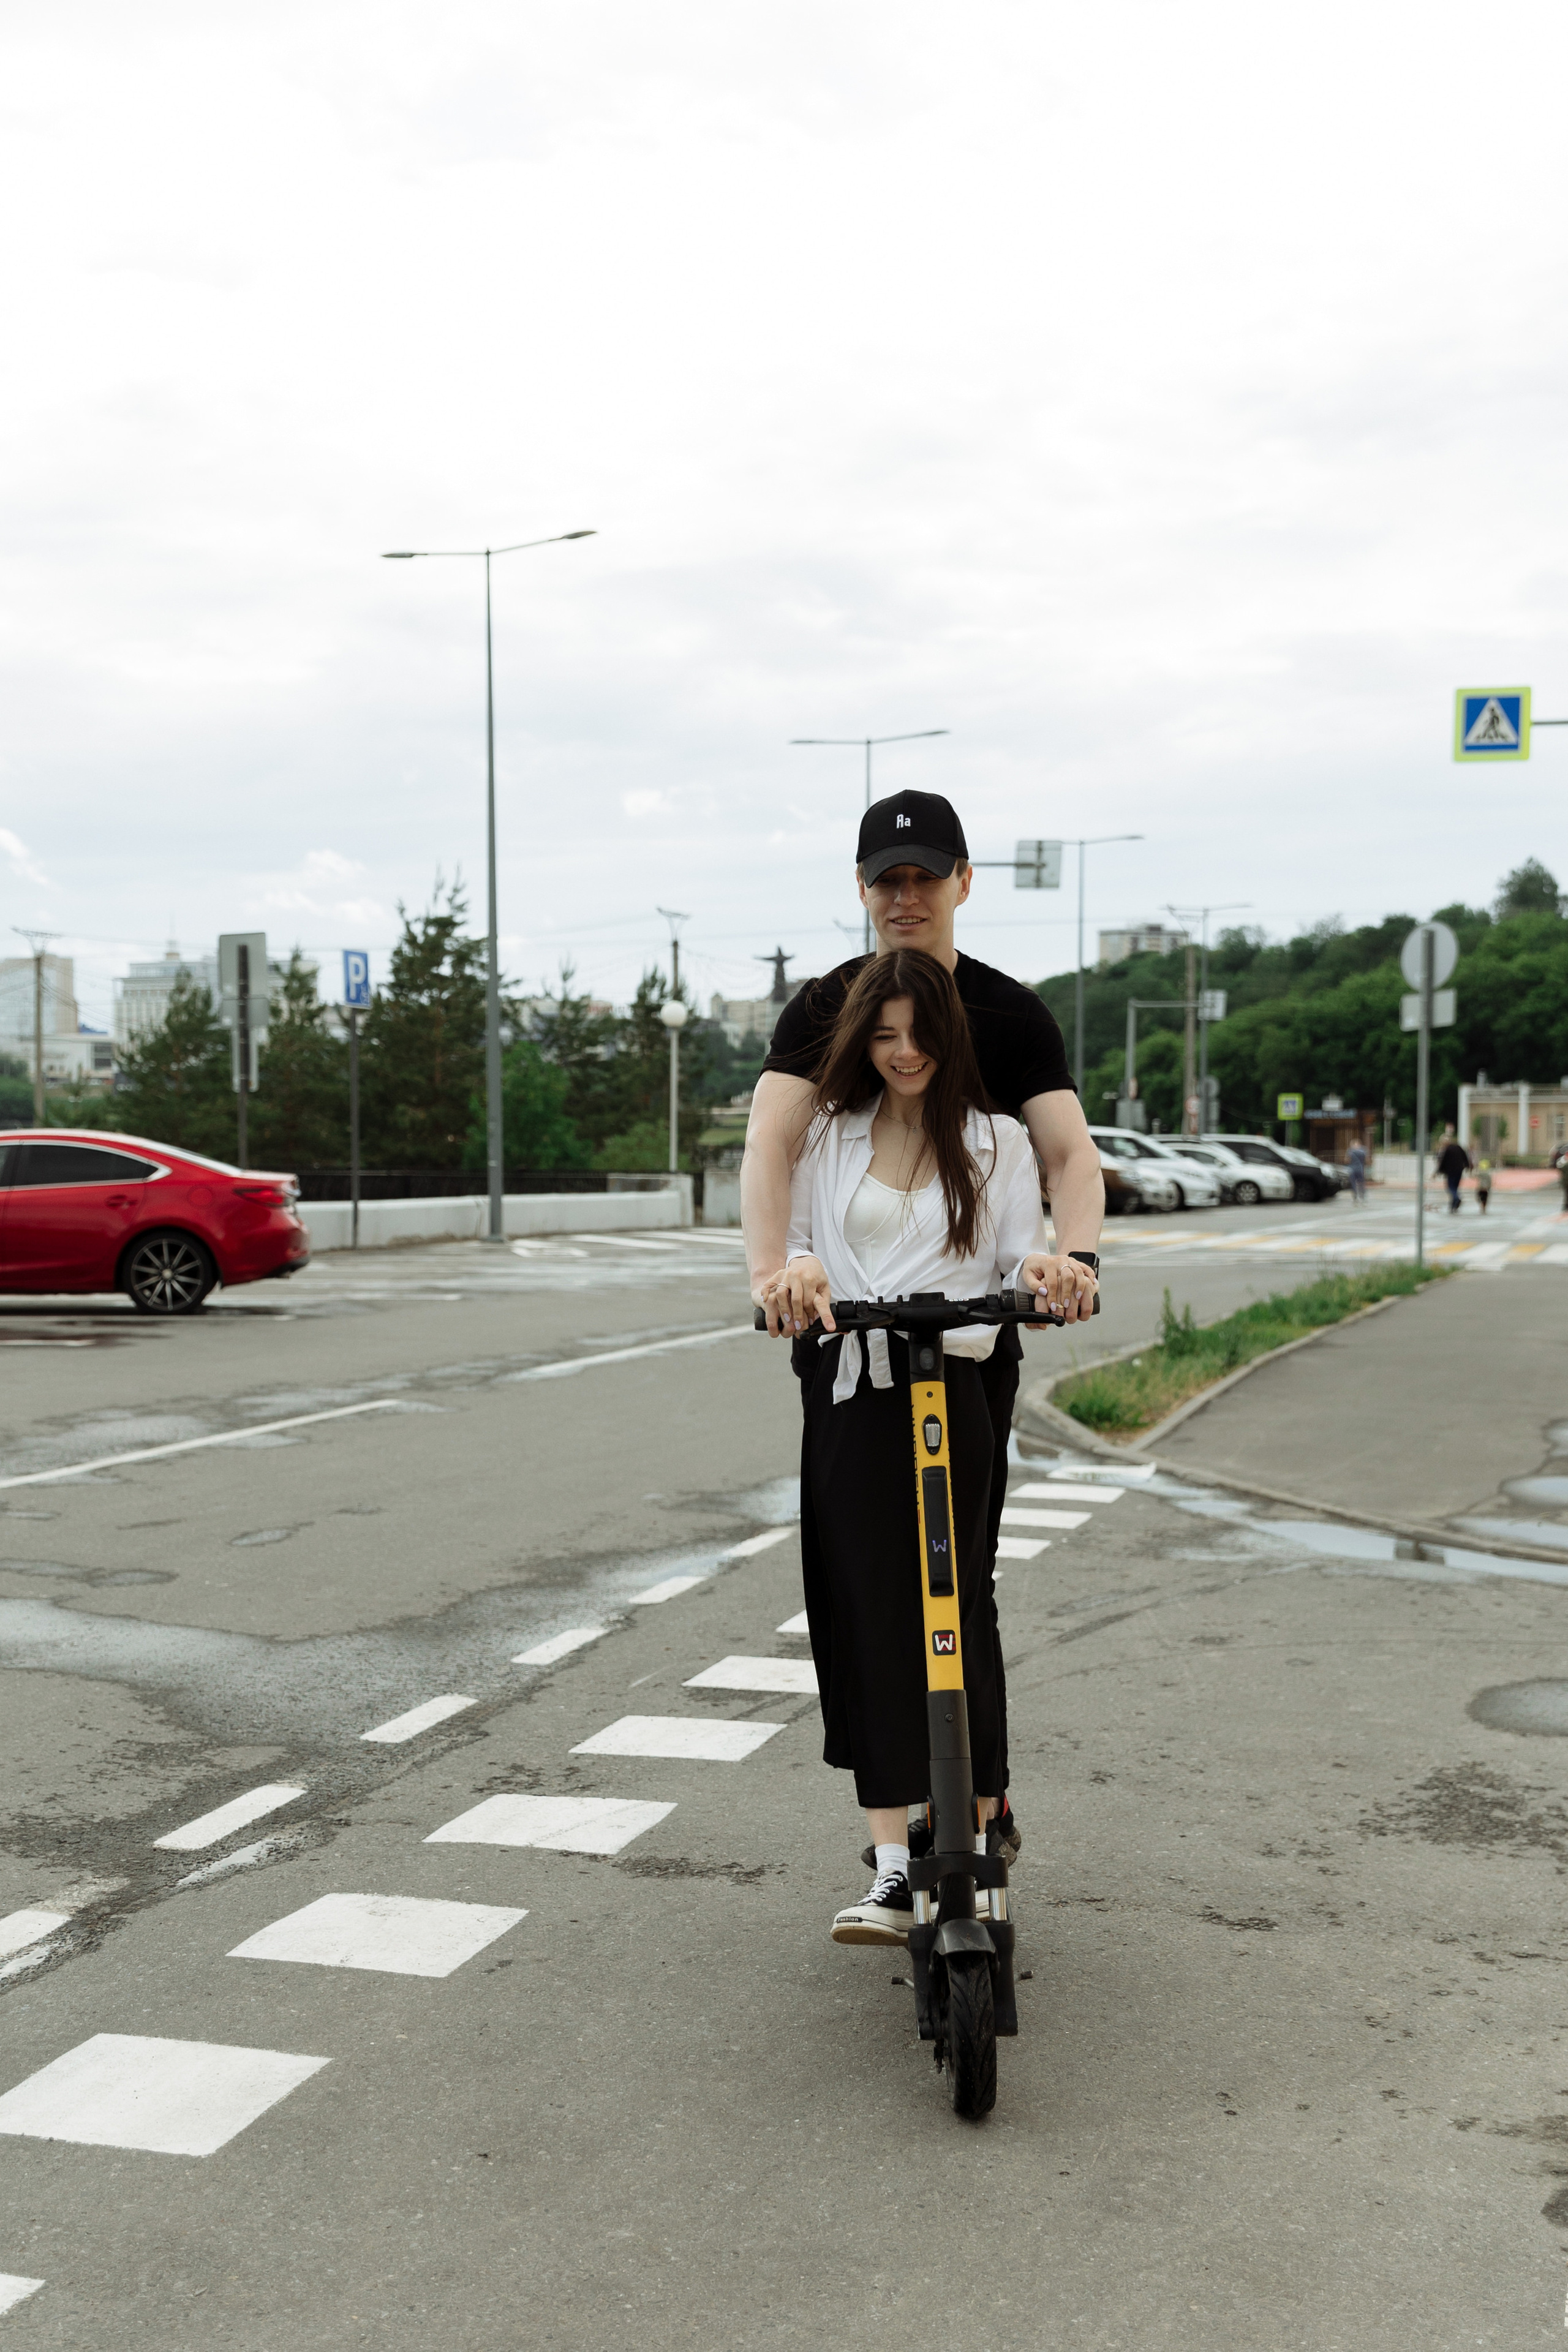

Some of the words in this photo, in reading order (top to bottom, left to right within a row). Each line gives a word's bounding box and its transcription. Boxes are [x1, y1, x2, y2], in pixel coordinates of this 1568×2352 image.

[896, 814, 911, 829] Aa
[348, 955, 366, 1000] P
[932, 1539, 947, 1553] W
[935, 1634, 953, 1651] W
